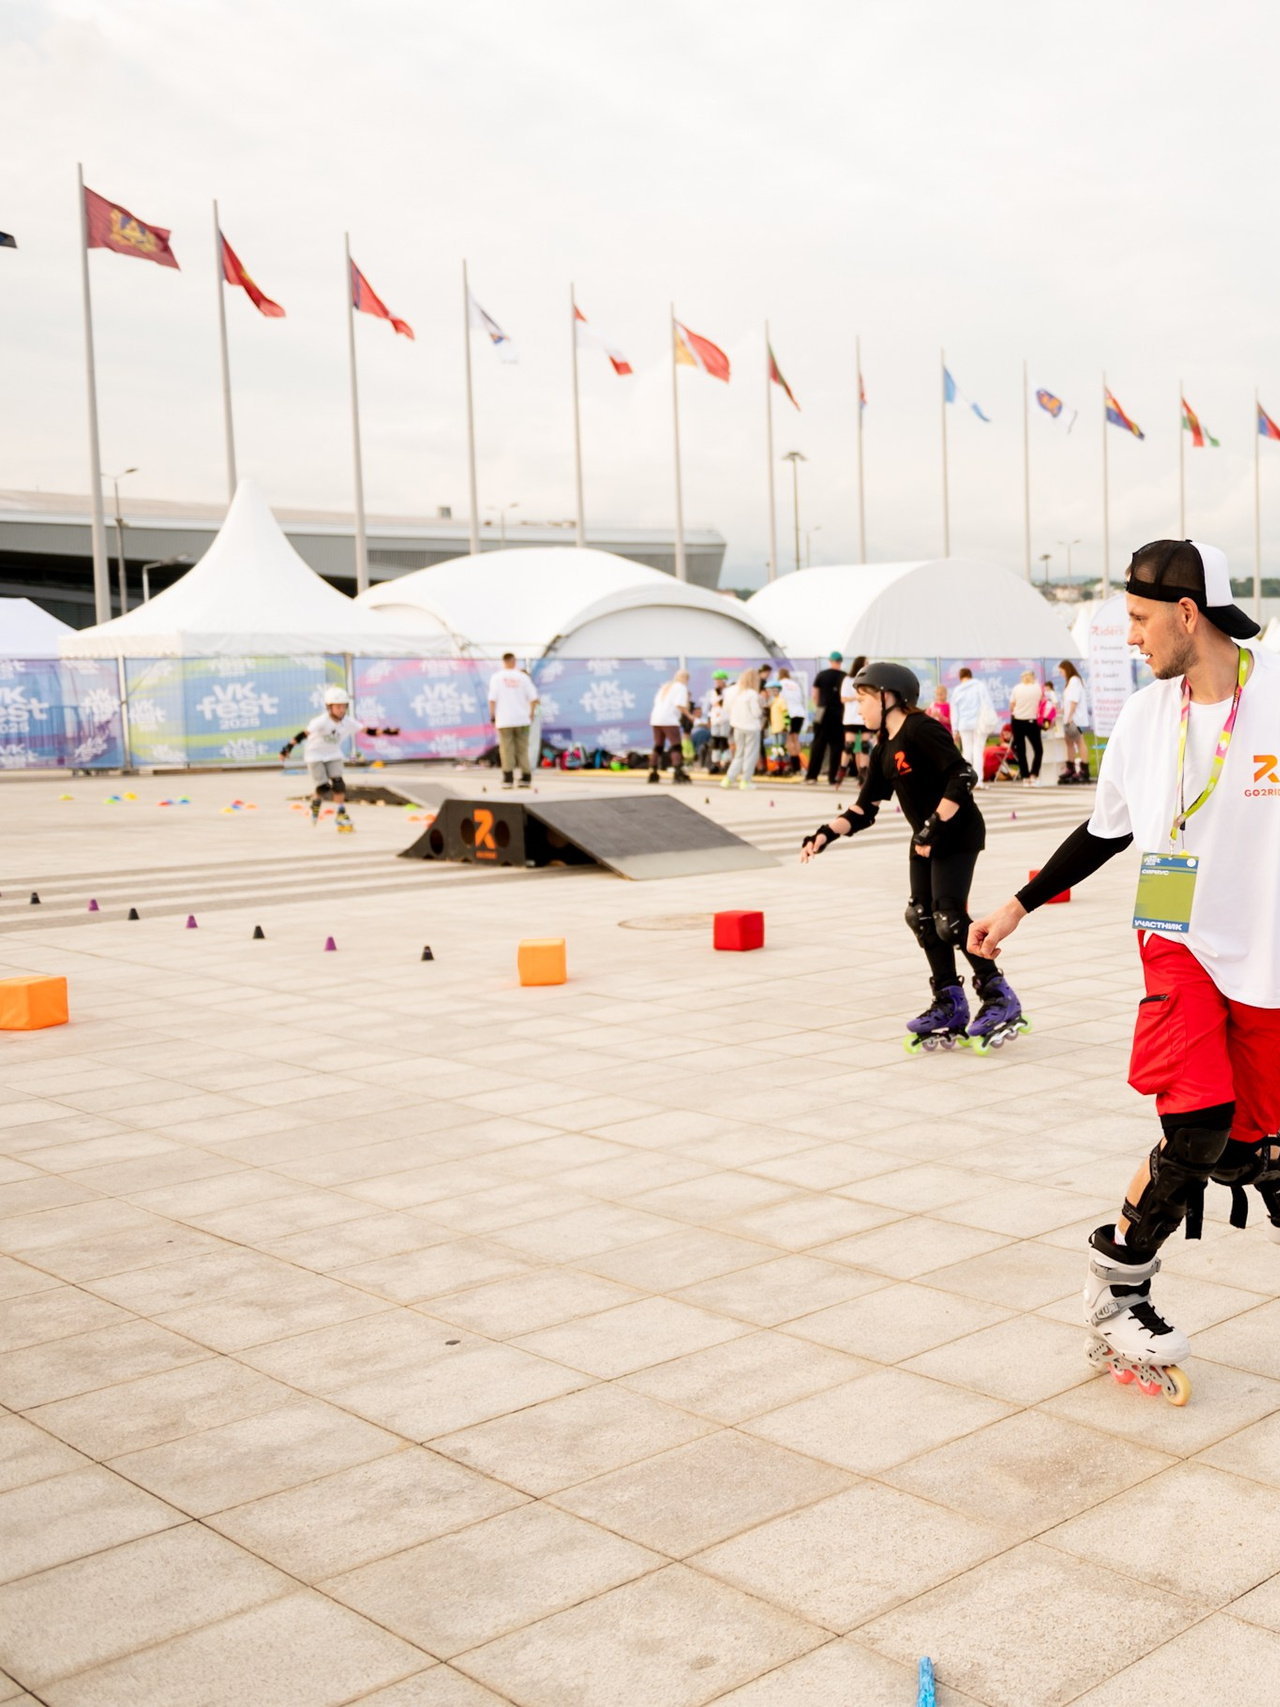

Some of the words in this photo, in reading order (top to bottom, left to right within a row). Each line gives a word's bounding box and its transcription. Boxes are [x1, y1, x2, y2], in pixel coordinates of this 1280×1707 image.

[213, 681, 256, 701] VK
[423, 681, 459, 699] VK
[589, 680, 621, 696] VK
[196, 691, 279, 721] fest
[409, 691, 477, 718] fest
[579, 689, 636, 714] fest
[219, 716, 260, 731] 2025
[1134, 919, 1183, 931] УЧАСТНИК
